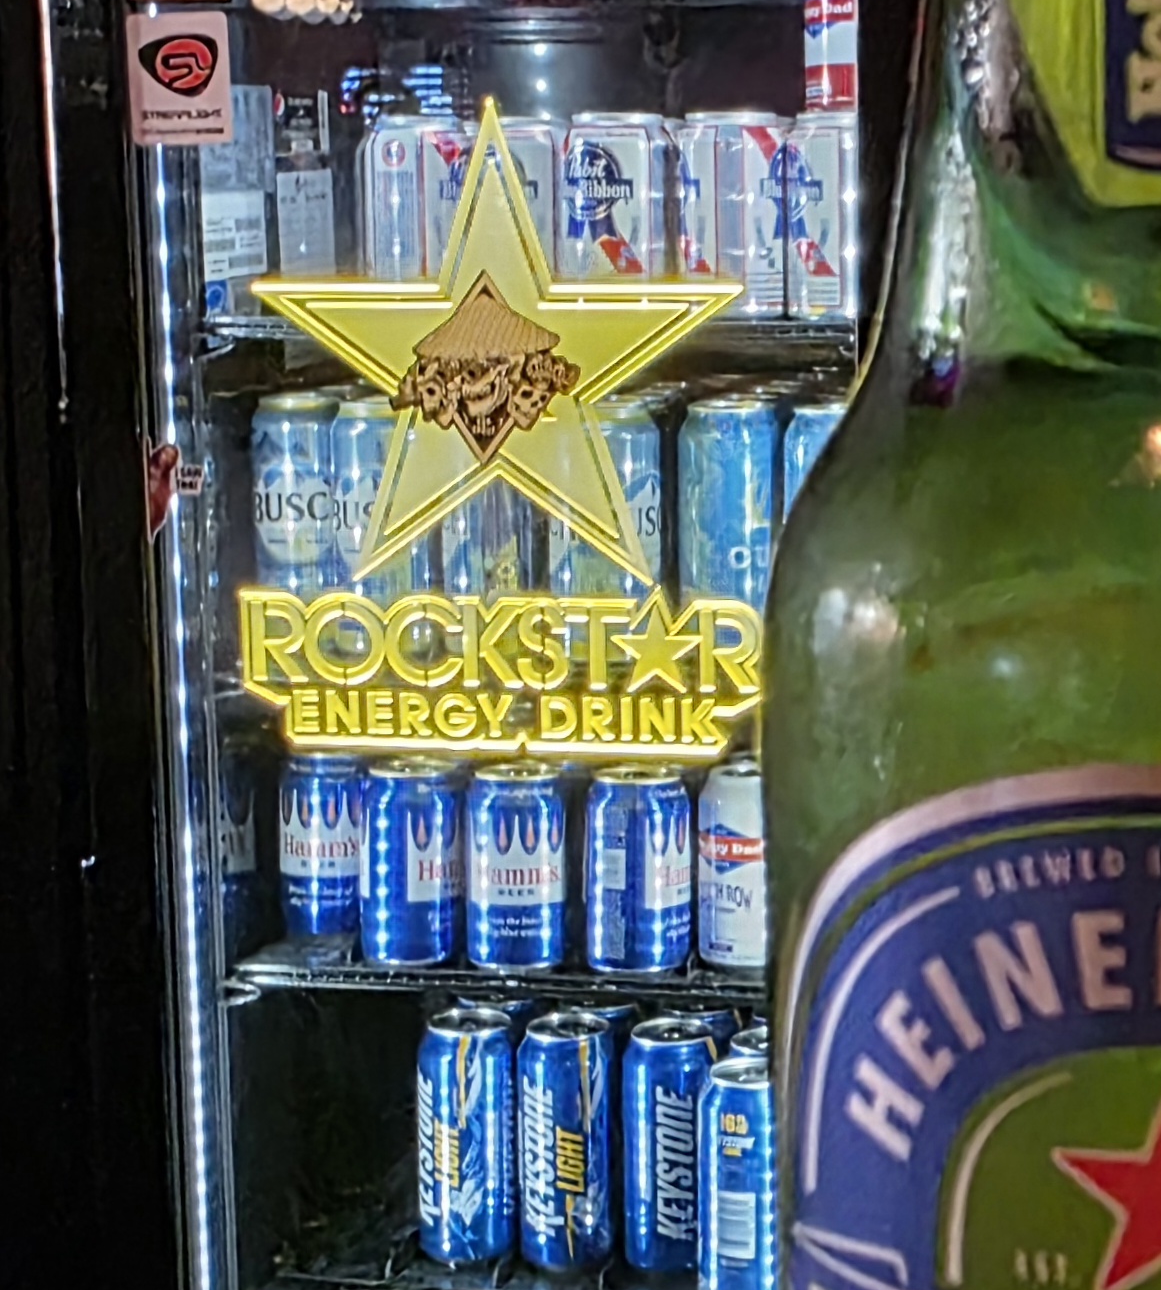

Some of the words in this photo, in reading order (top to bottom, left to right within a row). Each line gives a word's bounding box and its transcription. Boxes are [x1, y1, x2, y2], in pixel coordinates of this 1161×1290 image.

[580, 181, 631, 198] Ribbon
[255, 490, 329, 523] BUSC
[290, 687, 512, 738] ENERGY
[538, 694, 720, 746] DRINK
[523, 1074, 556, 1237] KEYSTONE
[556, 1125, 586, 1193] LIGHT
[655, 1085, 695, 1242] KEYSTONE
